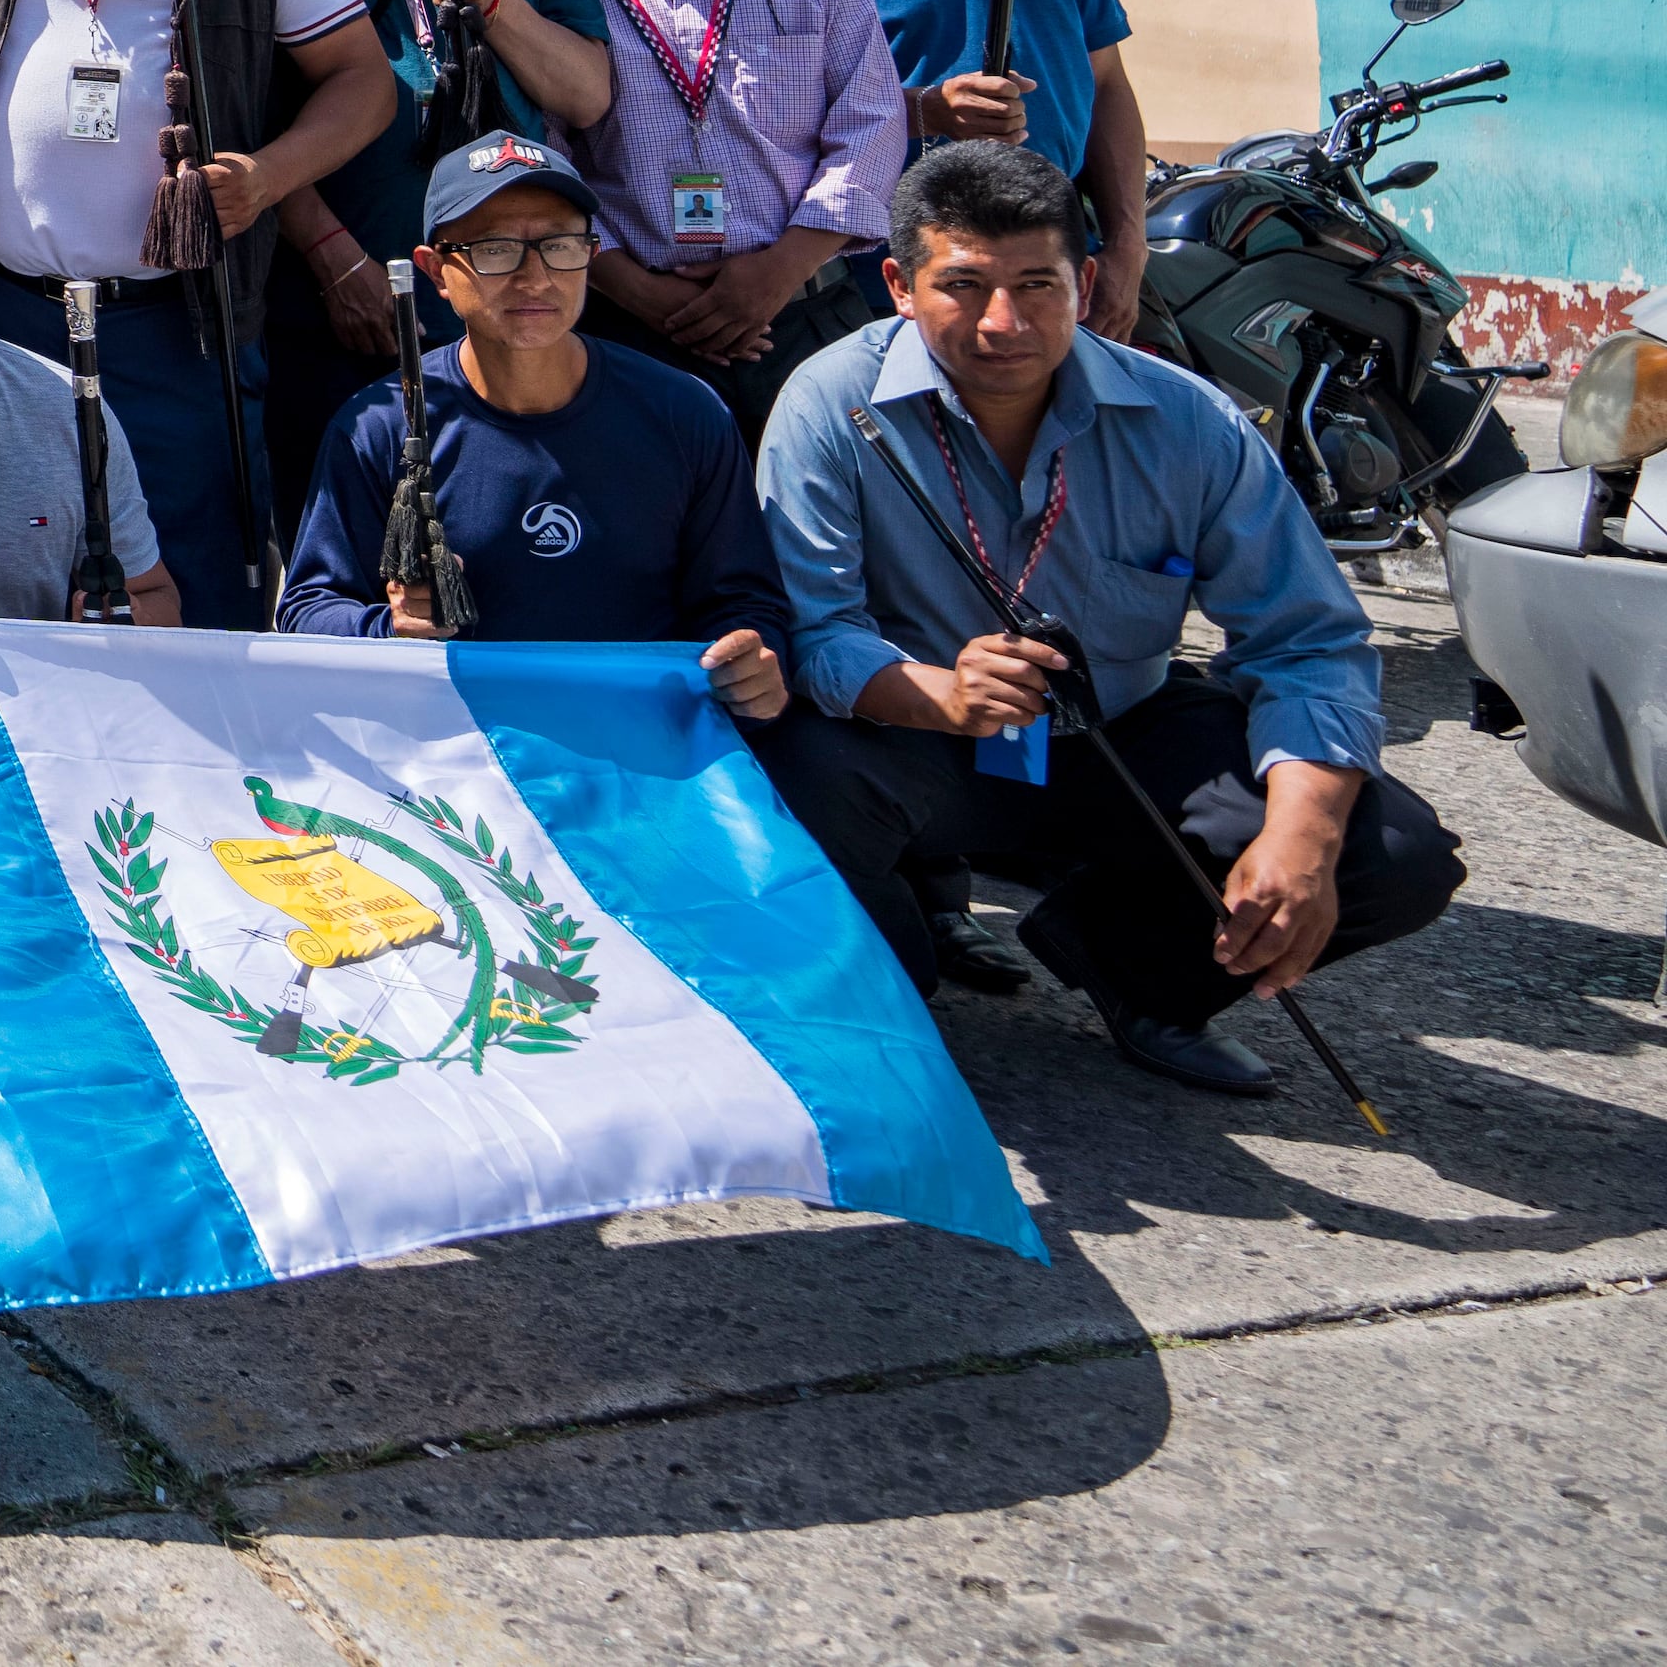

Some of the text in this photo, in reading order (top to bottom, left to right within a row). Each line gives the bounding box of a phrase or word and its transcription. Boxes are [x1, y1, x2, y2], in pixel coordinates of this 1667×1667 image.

[469, 145, 546, 170] JORDAN
[534, 536, 568, 546] adidas
[261, 865, 343, 887] LIBERTAD
[373, 912, 416, 930] 1821
